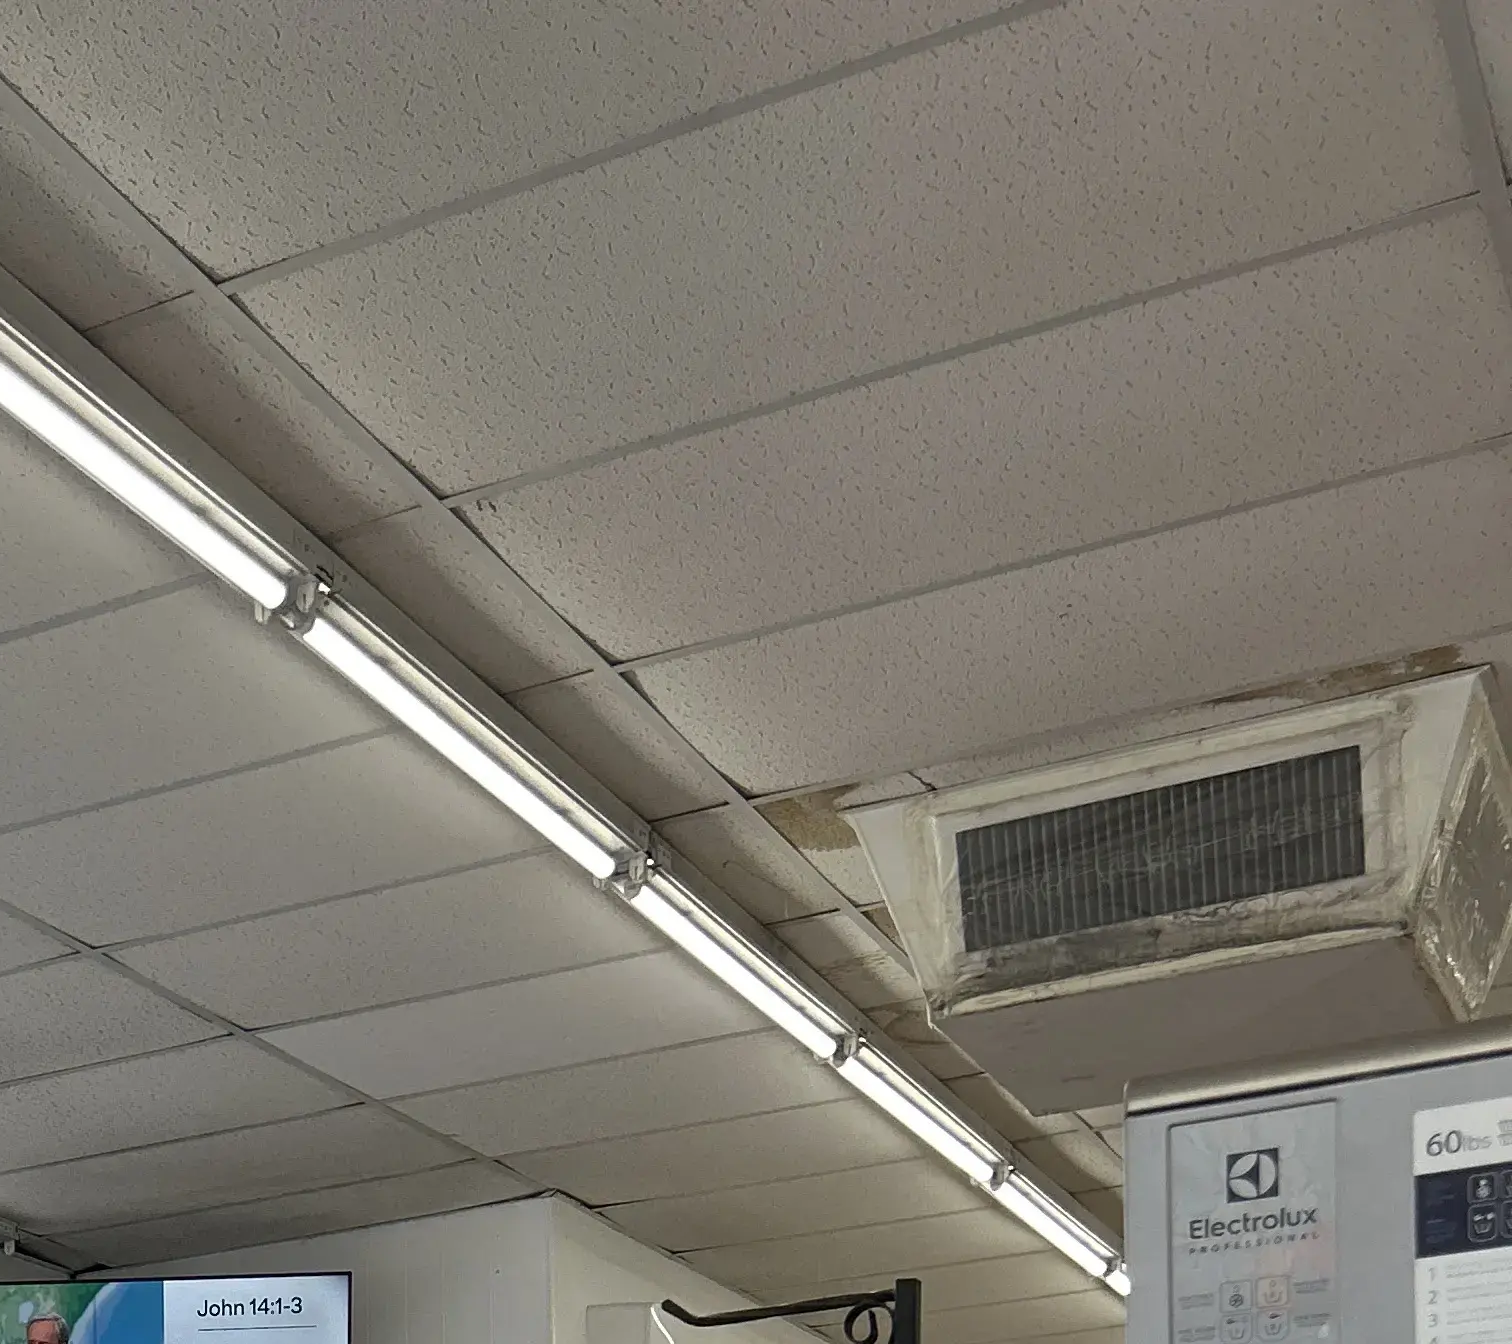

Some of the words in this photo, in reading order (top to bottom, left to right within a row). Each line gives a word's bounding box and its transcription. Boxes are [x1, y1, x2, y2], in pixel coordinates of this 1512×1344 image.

[1189, 1207, 1318, 1239] Electrolux
[1189, 1231, 1320, 1255] PROFESSIONAL
[197, 1299, 245, 1317] John
[250, 1297, 303, 1315] 14:1-3
[1428, 1290, 1439, 1305] 2
[1428, 1313, 1438, 1328] 3
